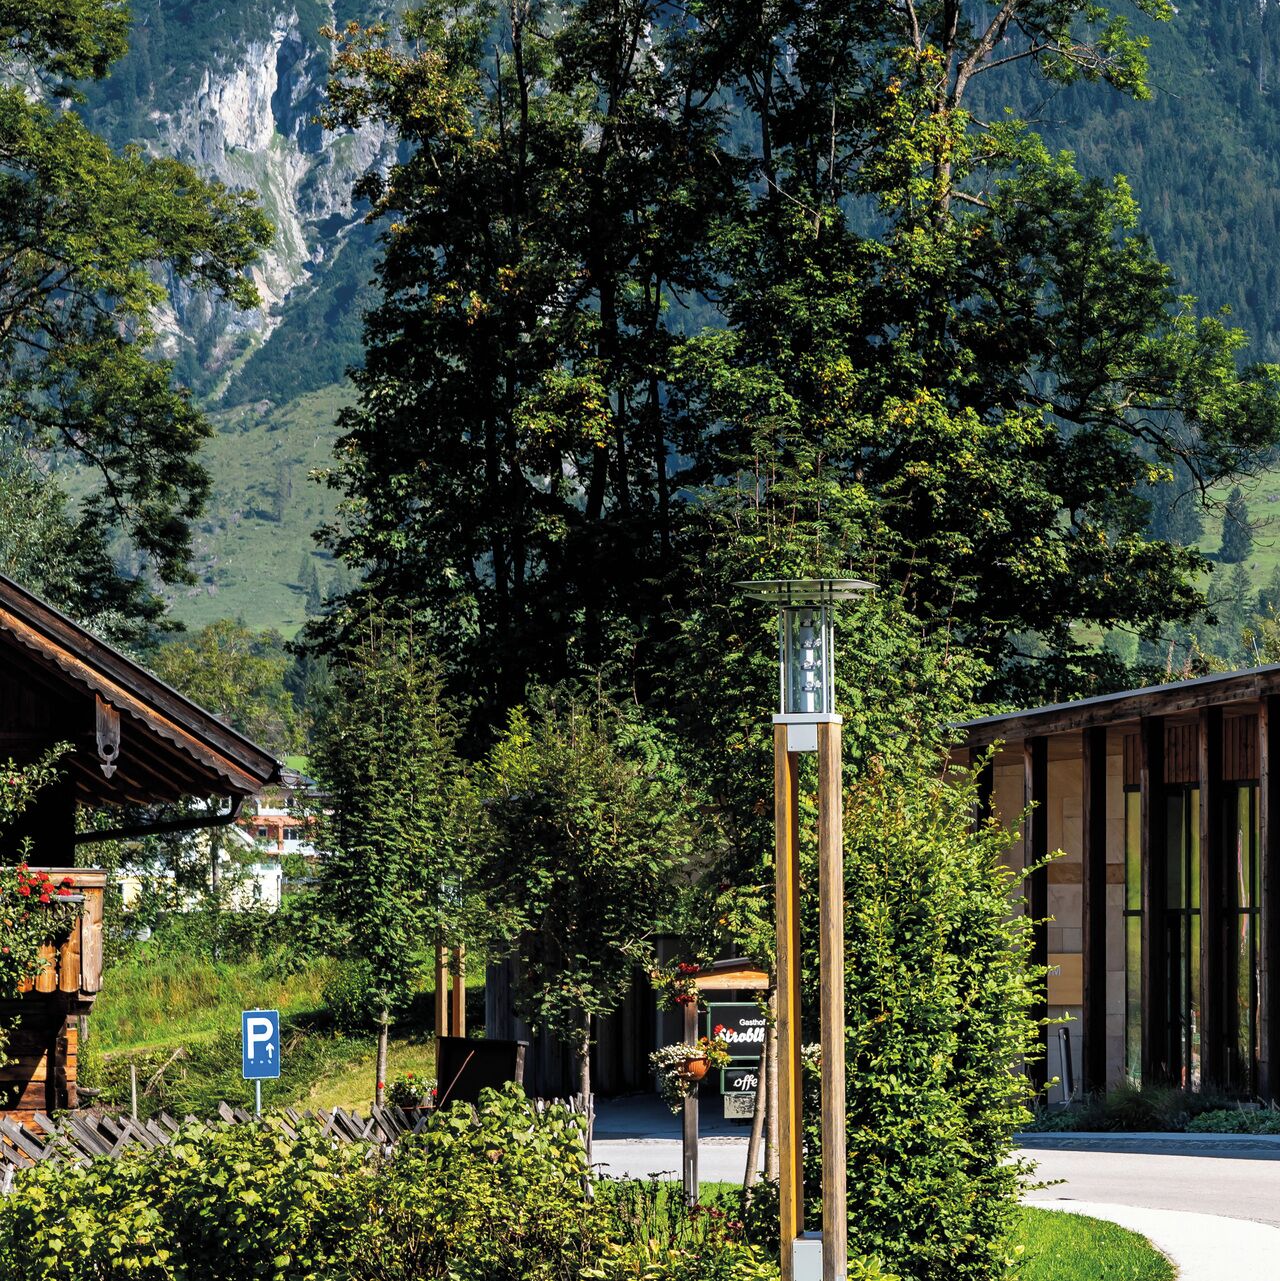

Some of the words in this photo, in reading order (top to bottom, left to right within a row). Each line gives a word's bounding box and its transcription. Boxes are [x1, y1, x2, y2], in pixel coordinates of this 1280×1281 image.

[247, 1018, 273, 1059] P
[718, 1027, 765, 1043] Stroblh
[733, 1074, 757, 1090] offe
